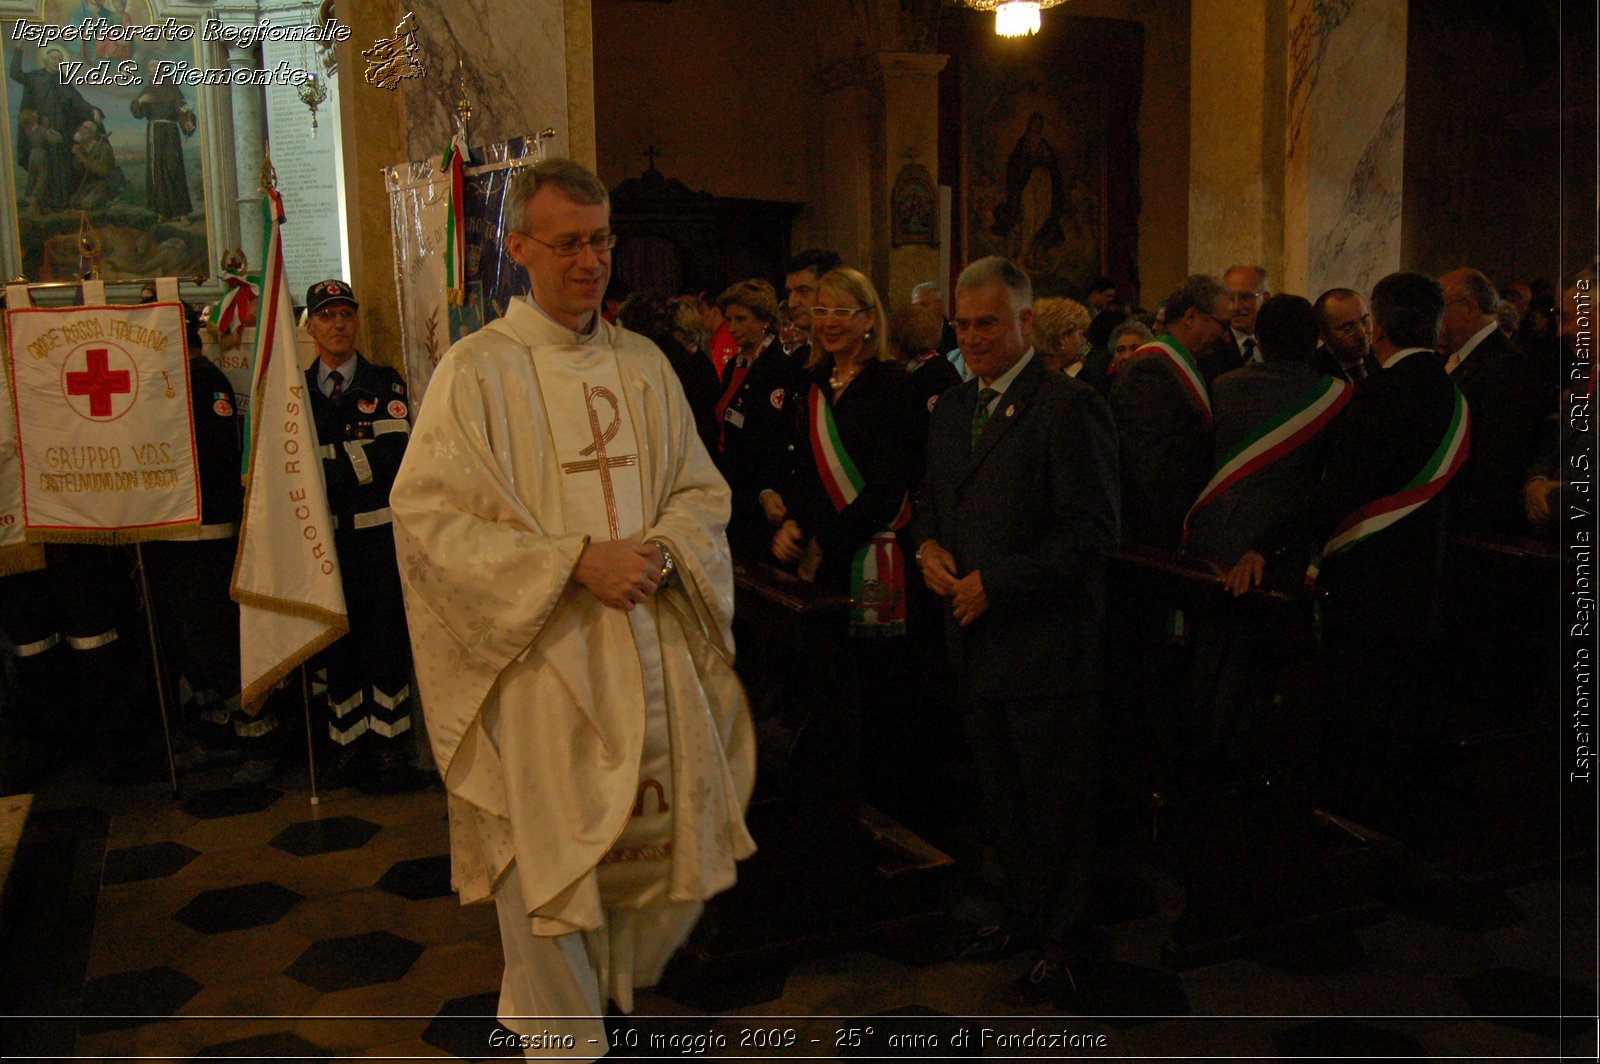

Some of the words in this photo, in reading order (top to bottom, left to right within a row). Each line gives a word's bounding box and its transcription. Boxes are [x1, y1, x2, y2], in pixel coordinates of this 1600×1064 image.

[61, 318, 104, 345] ROSSA
[45, 446, 121, 470] GRUPPO
[131, 443, 175, 466] V.D.S.
[284, 385, 303, 474] ROSSA
[289, 488, 334, 575] CROCE
